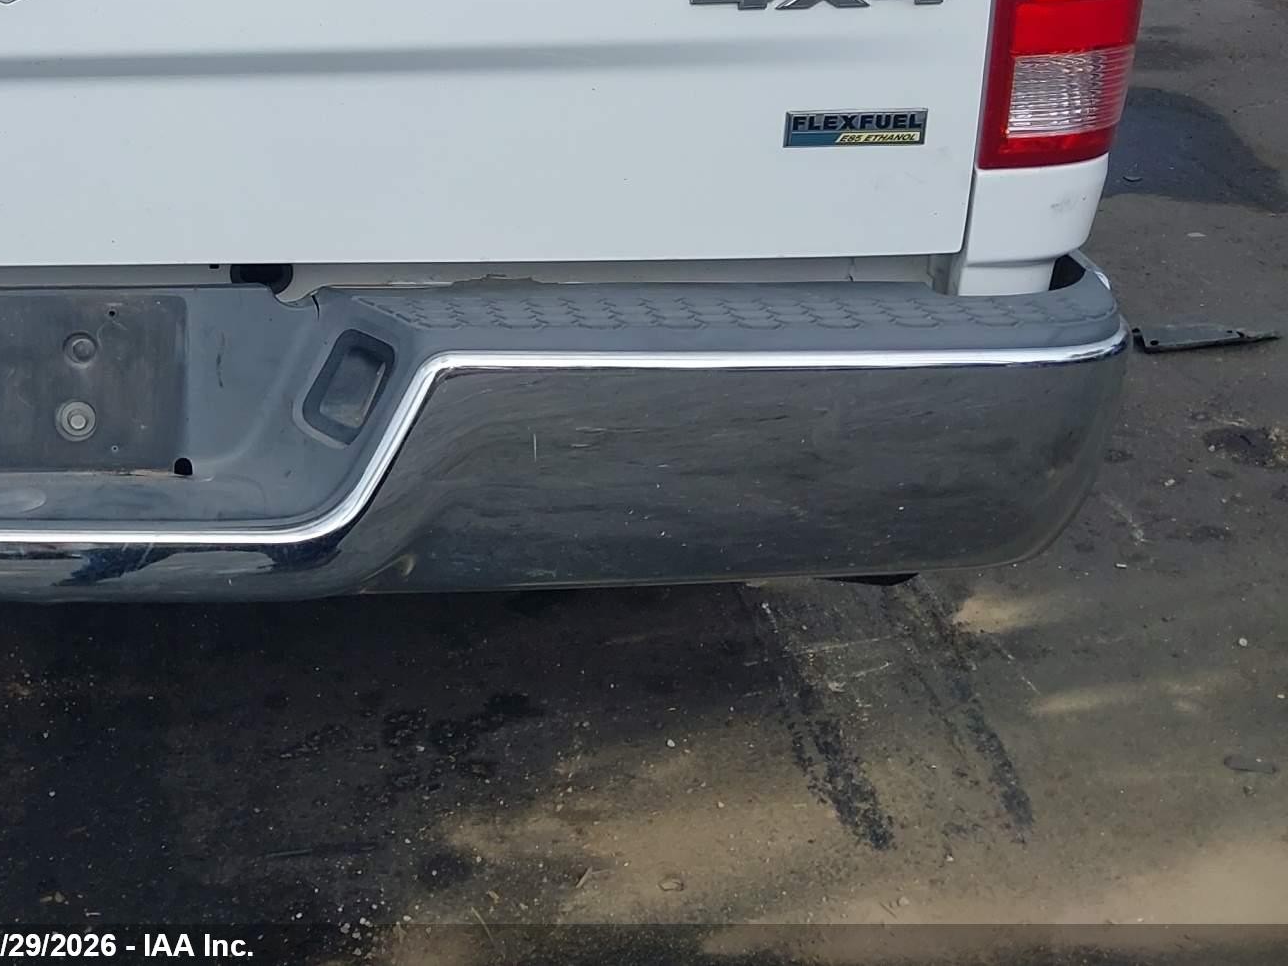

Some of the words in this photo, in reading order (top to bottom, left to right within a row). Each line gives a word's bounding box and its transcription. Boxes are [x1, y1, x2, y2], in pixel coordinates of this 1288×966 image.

[792, 113, 923, 132] FLEXFUEL
[840, 134, 862, 143] E85
[865, 133, 916, 142] ETHANOL
